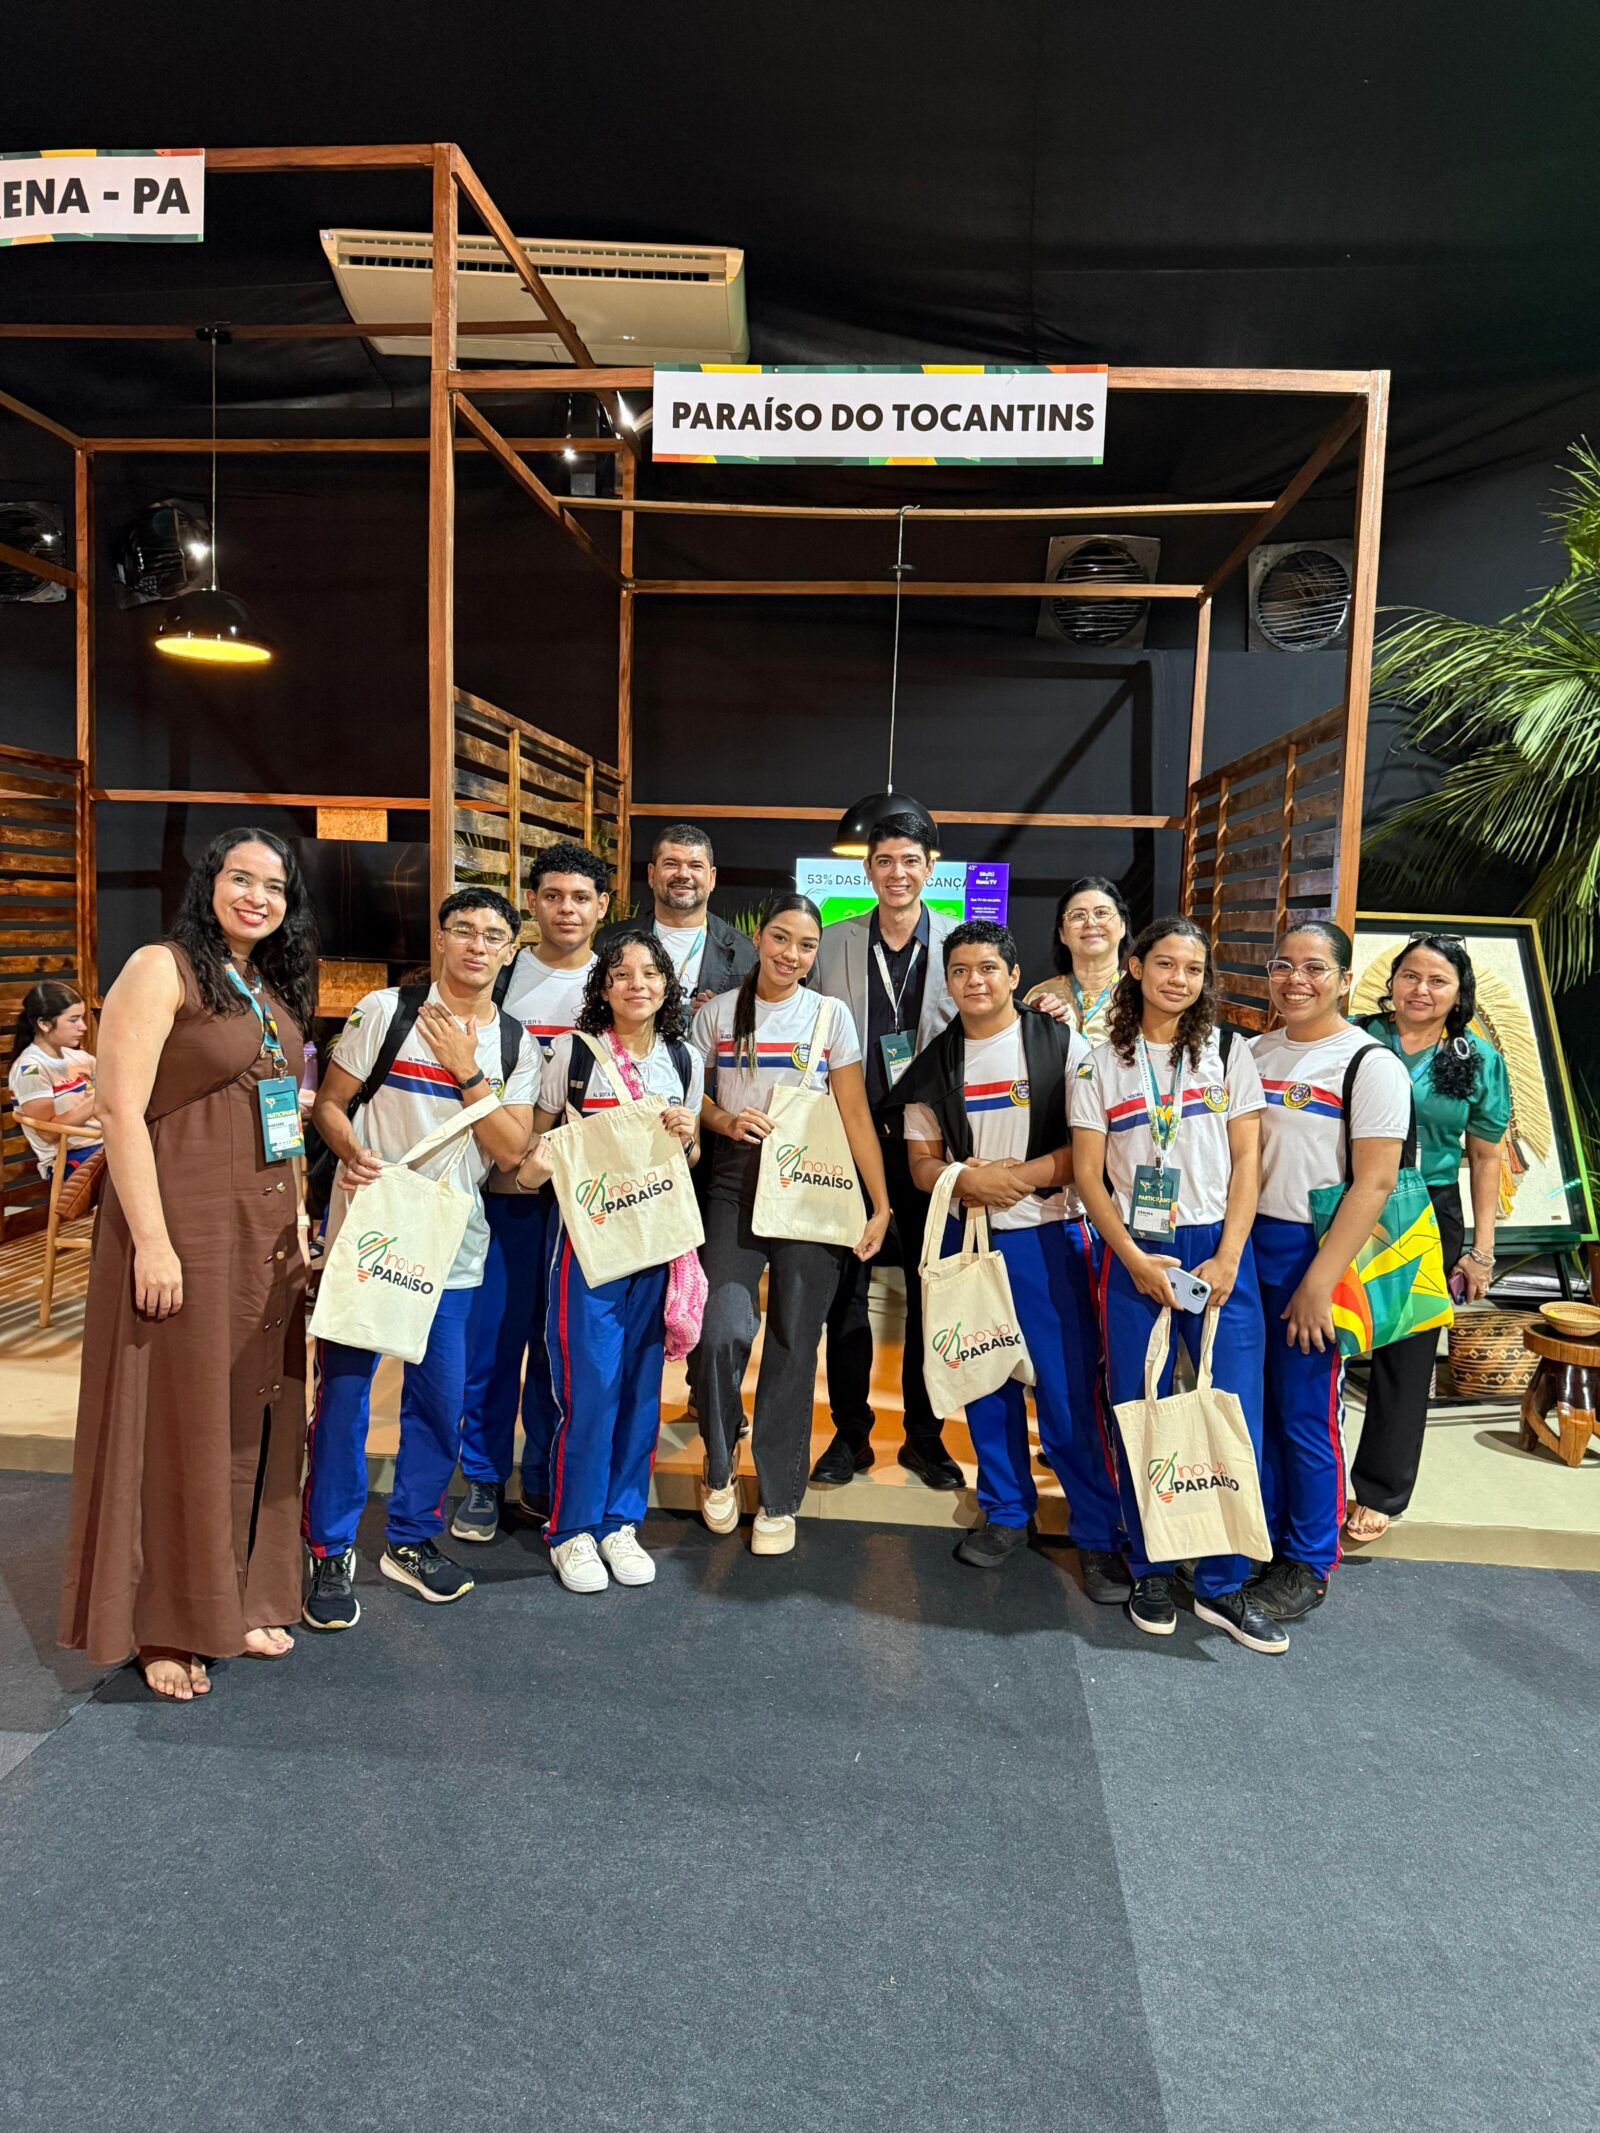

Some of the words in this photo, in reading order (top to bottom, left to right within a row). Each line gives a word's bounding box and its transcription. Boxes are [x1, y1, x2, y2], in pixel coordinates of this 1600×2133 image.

[0, 178, 90, 218] ENA
[103, 191, 119, 200] -
[133, 178, 190, 214] PA
[672, 397, 822, 431] PARAÍSO
[831, 403, 884, 431] DO
[892, 403, 1094, 432] TOCANTINS
[807, 874, 833, 885] 53%
[835, 875, 861, 885] DAS
[793, 1171, 853, 1190] PARAÍSO
[604, 1179, 673, 1213] PARAÍSO
[372, 1265, 434, 1294] PARAÍSO
[1174, 1472, 1239, 1492] PARAÍSO
